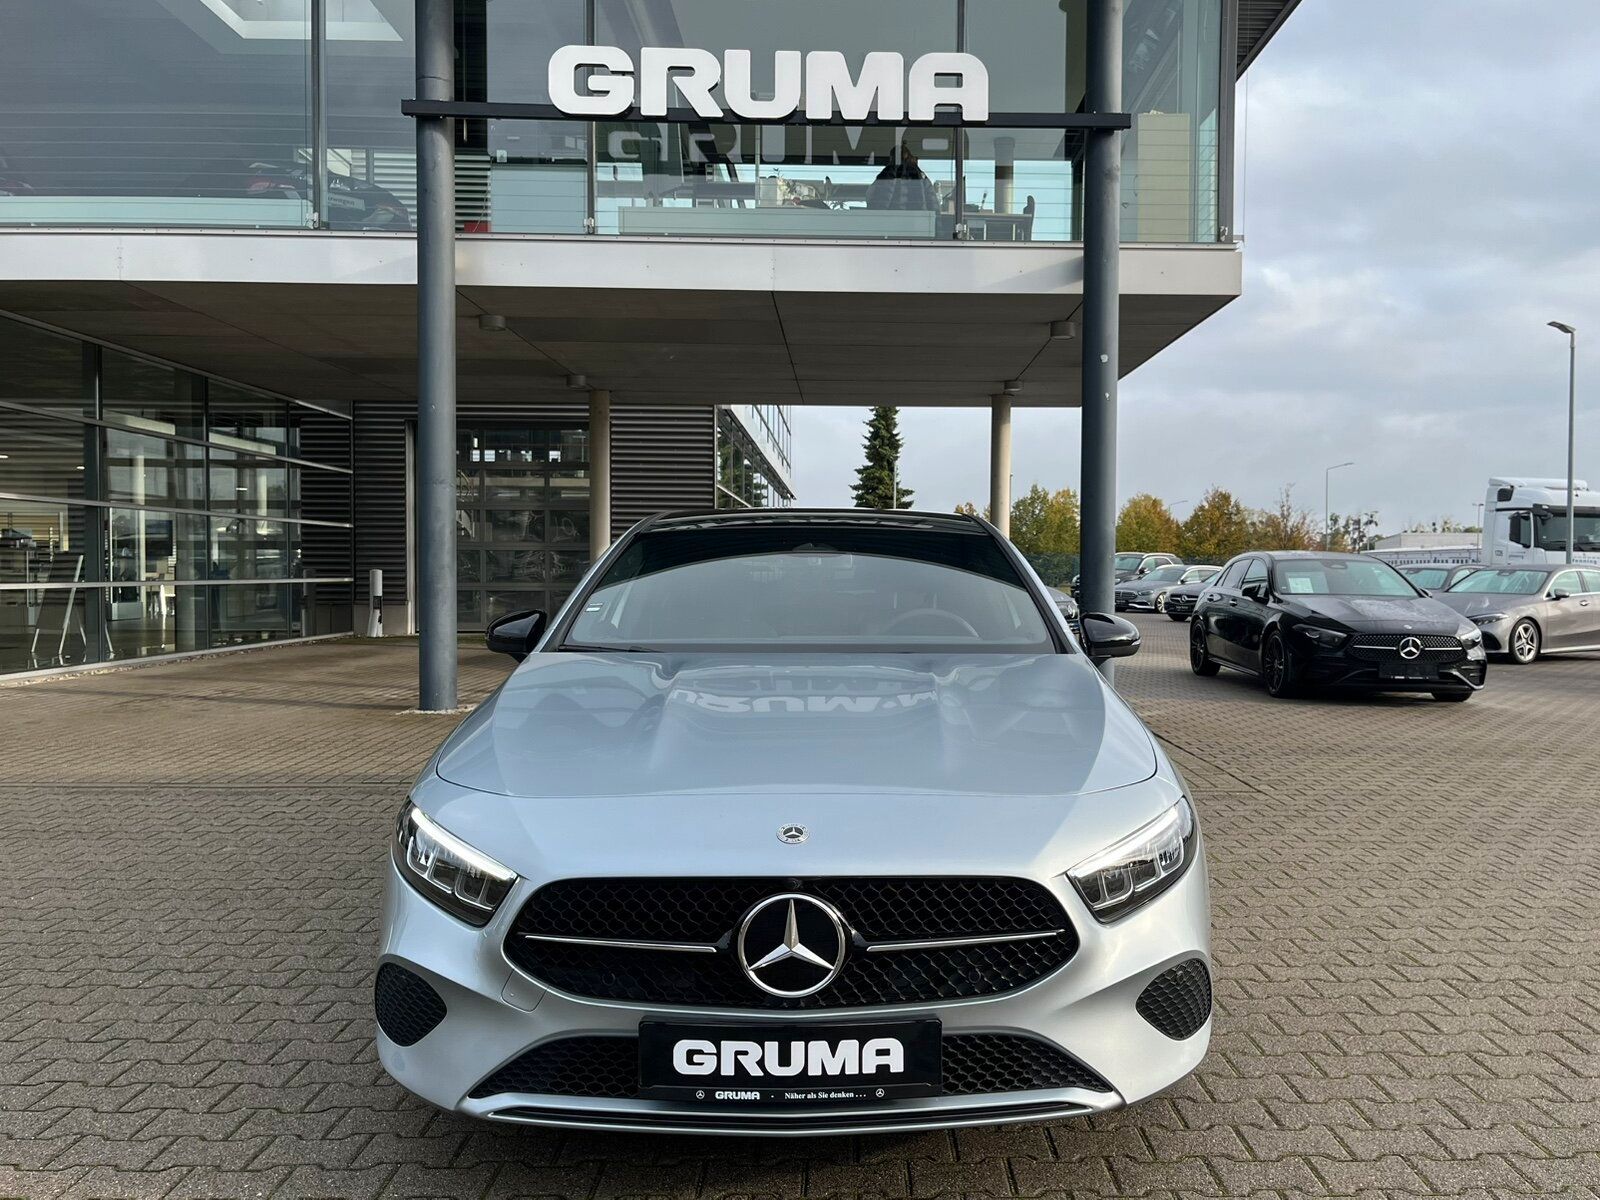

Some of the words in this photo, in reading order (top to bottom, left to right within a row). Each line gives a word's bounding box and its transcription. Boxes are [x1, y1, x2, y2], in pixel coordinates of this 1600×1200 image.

[548, 45, 989, 121] GRUMA
[673, 1037, 904, 1077] GRUMA
[715, 1091, 760, 1100] GRUMA
[785, 1092, 806, 1100] Näher
[807, 1091, 817, 1099] als
[818, 1091, 829, 1099] Sie
[830, 1091, 855, 1099] denken
